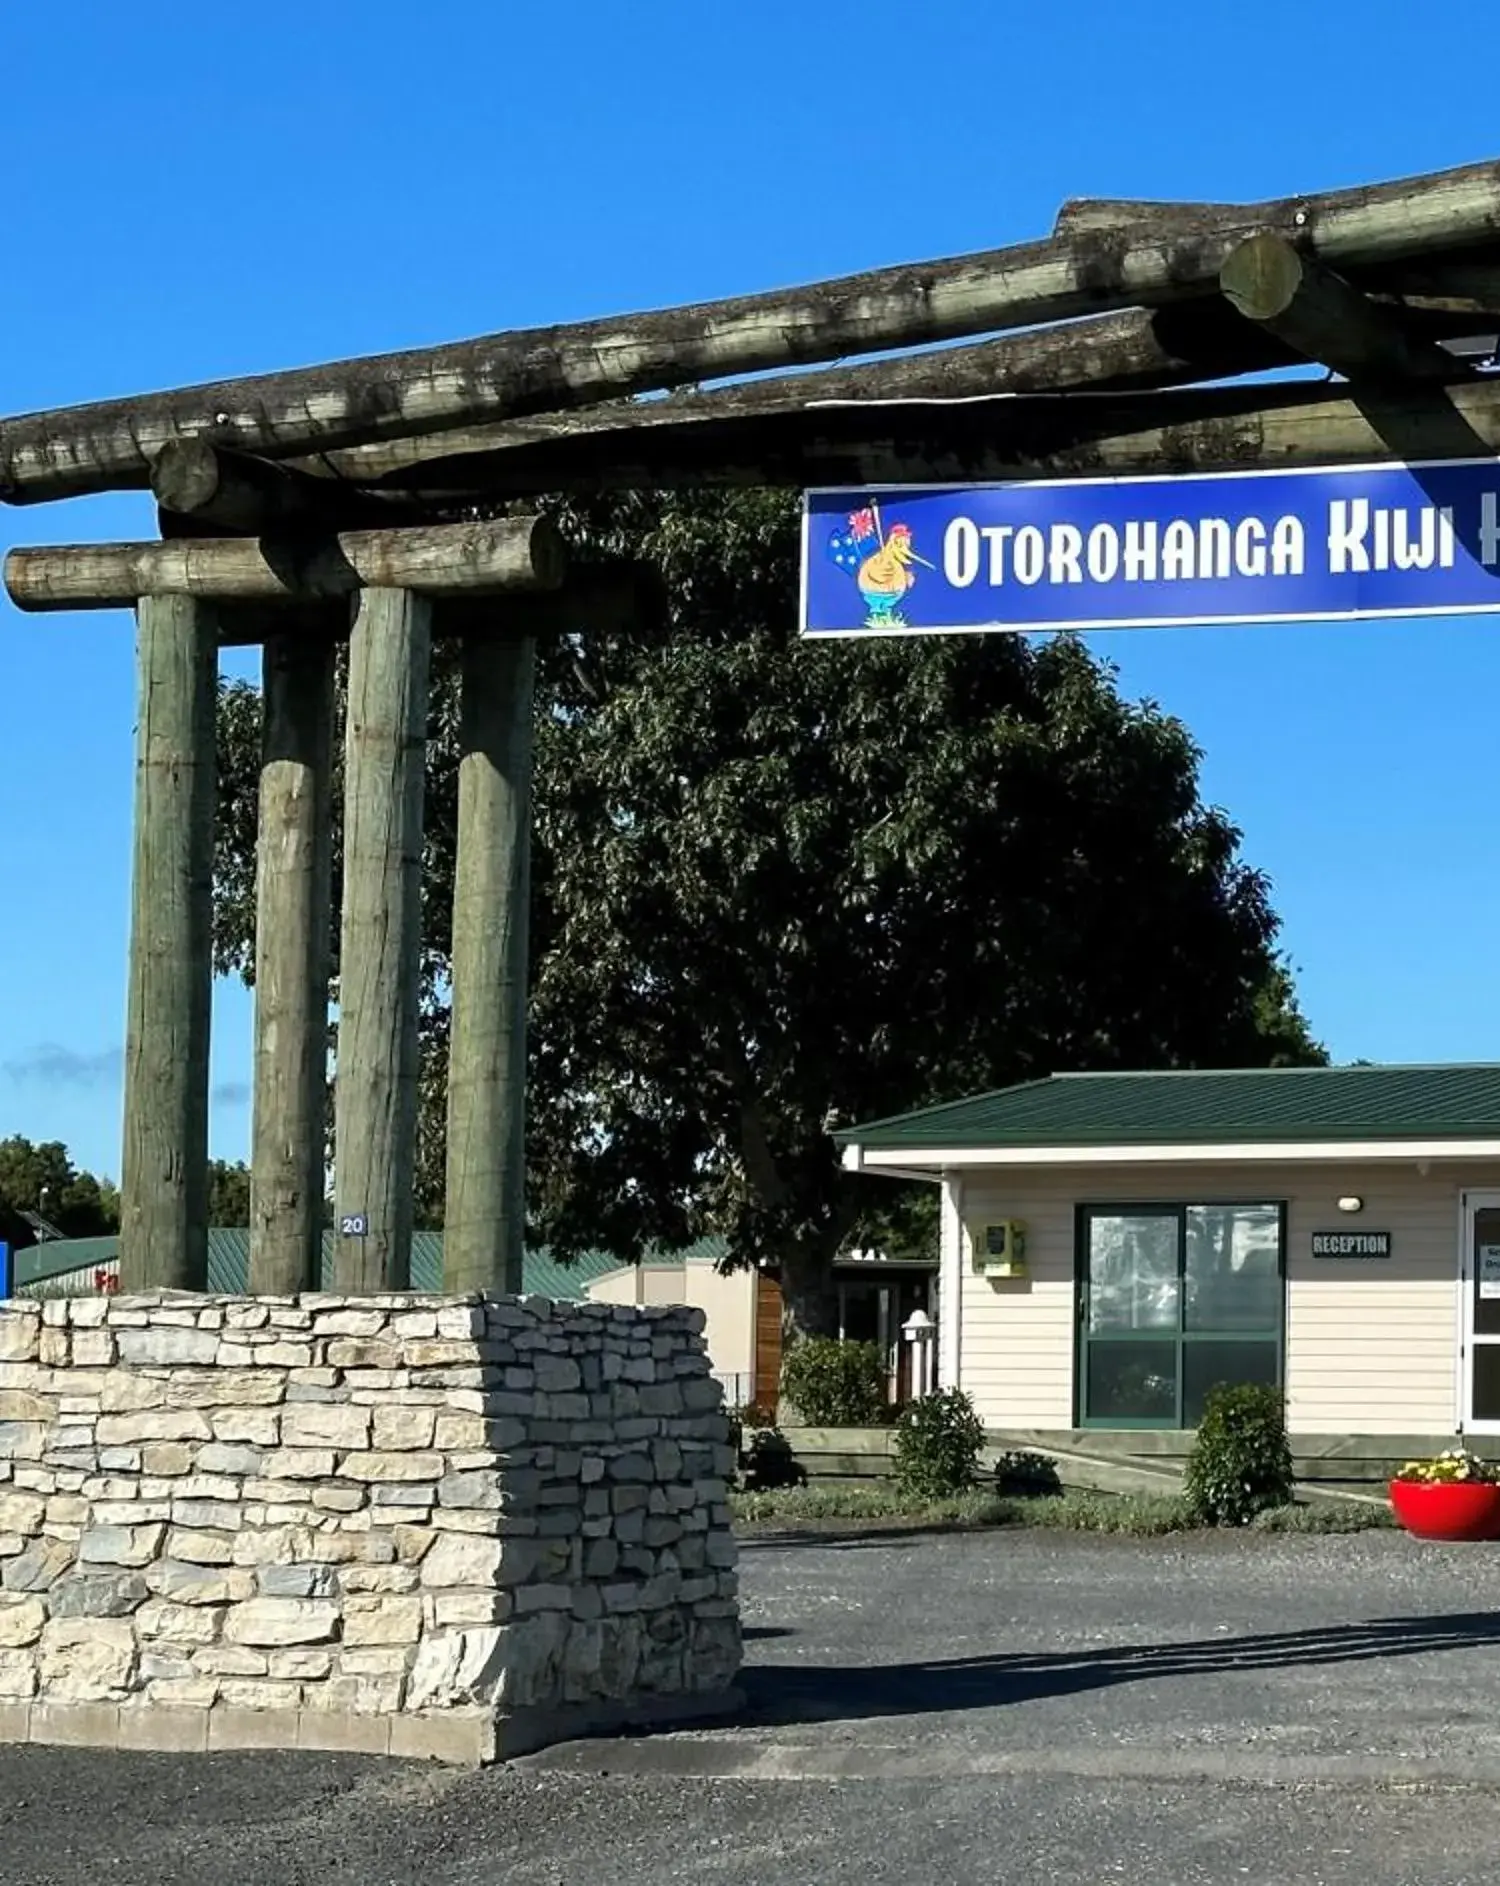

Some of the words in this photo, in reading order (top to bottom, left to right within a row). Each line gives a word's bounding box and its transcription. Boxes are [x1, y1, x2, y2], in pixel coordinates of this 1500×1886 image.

[943, 514, 1305, 588] OTOROHANGA
[1327, 497, 1455, 573] KIWI
[342, 1218, 363, 1233] 20
[1313, 1235, 1387, 1253] RECEPTION
